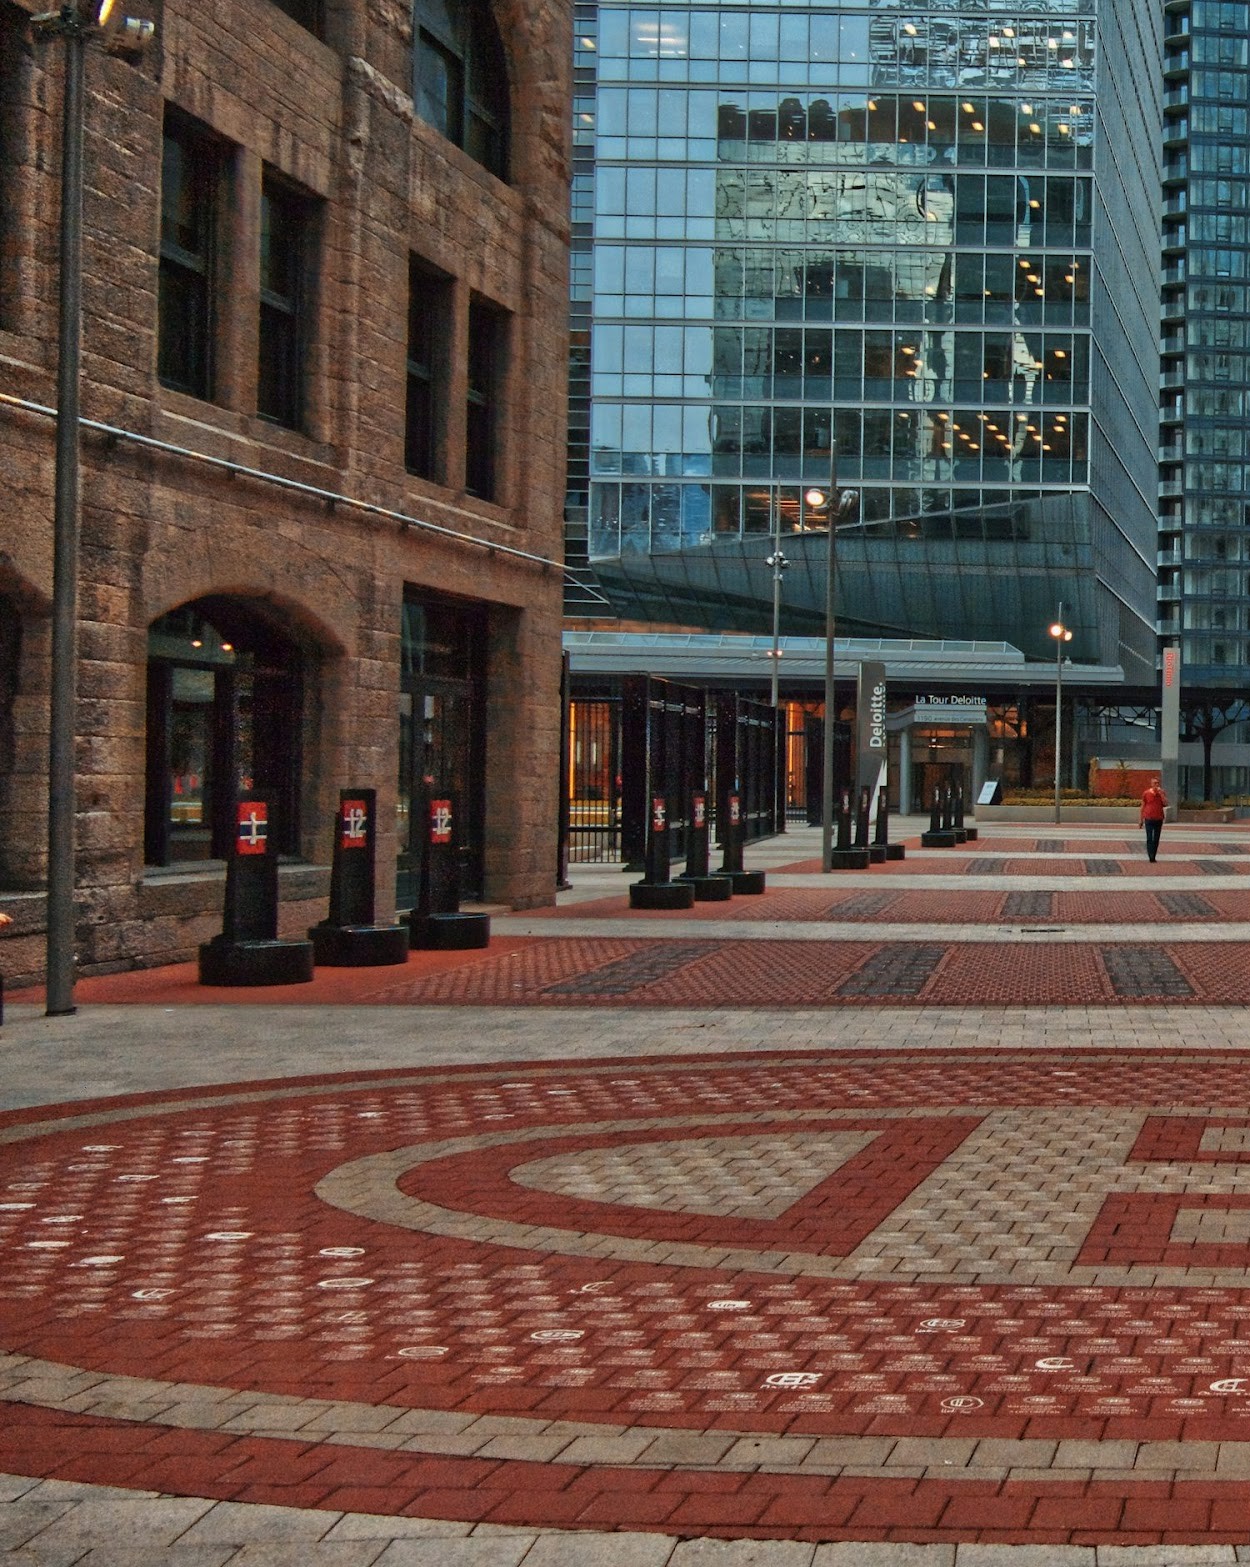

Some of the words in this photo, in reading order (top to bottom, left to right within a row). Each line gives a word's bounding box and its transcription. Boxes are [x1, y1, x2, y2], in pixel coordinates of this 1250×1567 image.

[916, 695, 925, 705] La
[928, 695, 949, 705] Tour
[951, 695, 987, 705] Deloitte
